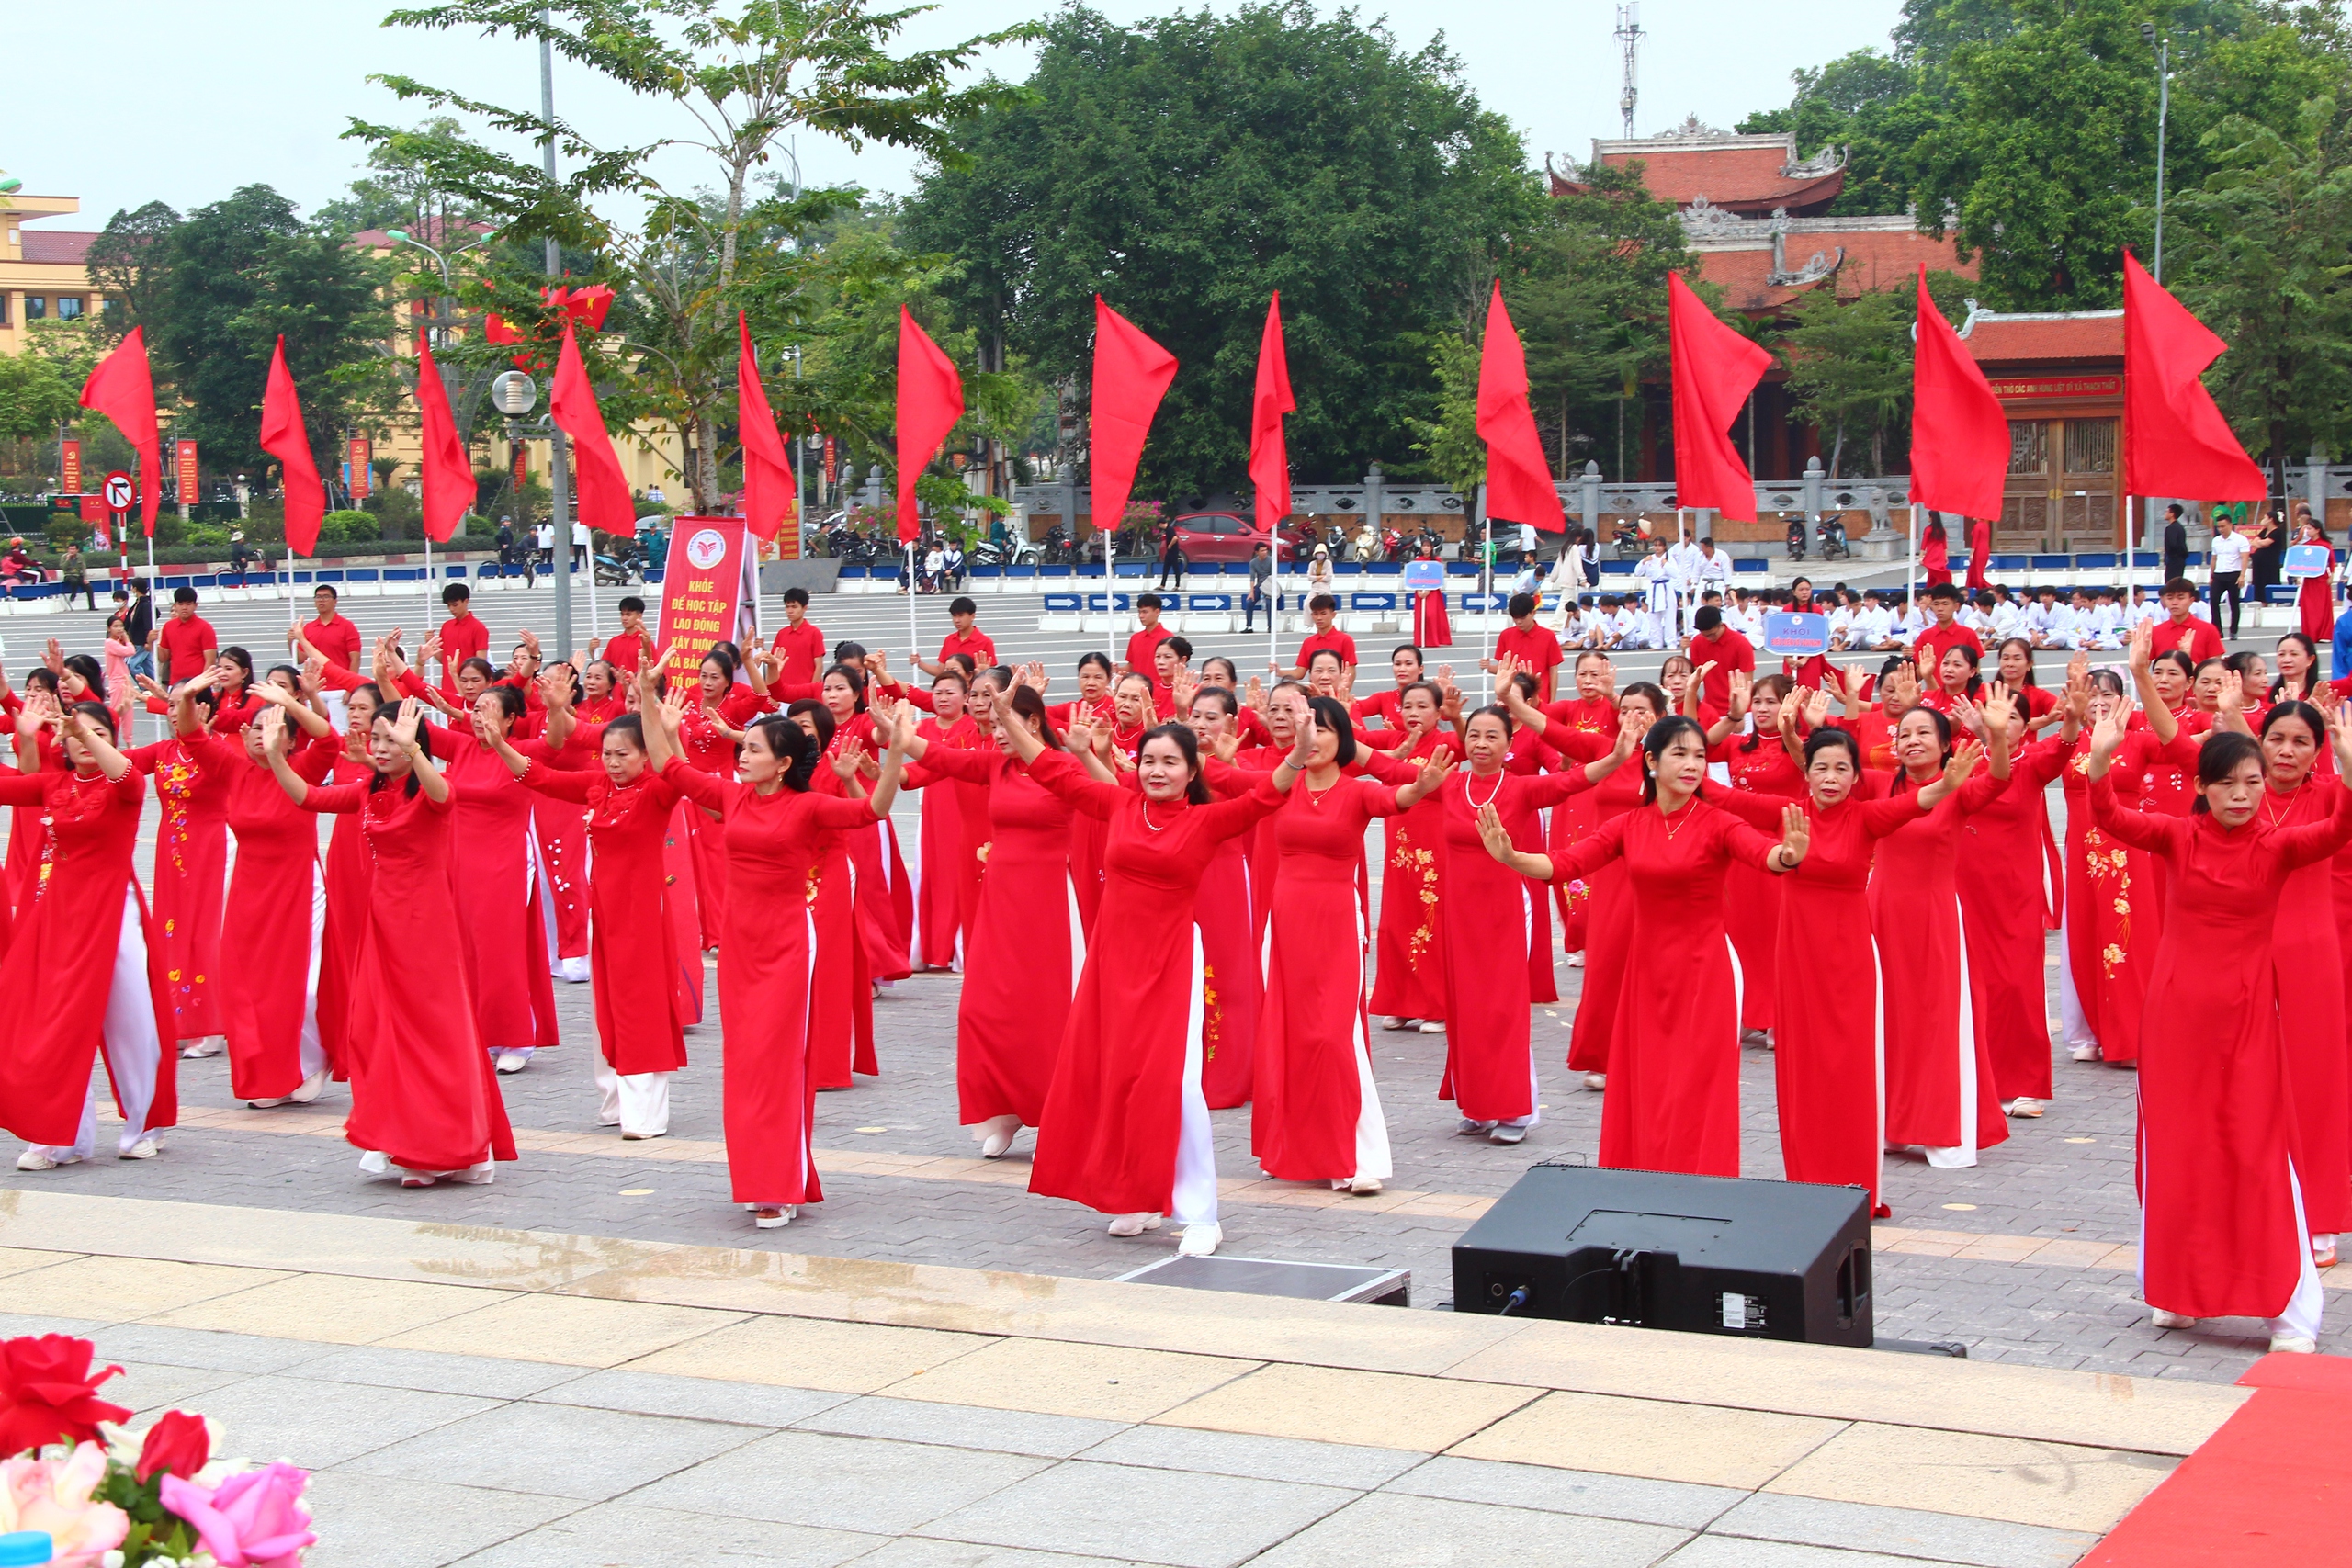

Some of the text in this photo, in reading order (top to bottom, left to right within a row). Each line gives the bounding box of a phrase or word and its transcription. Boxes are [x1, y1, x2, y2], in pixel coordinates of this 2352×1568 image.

[2015, 382, 2026, 393] CÁC
[2026, 383, 2038, 393] ANH
[689, 578, 714, 593] KHỎE
[672, 595, 727, 615] ĐỂ HỌC TẬP
[673, 617, 720, 634] LAO ĐỘNG
[672, 635, 690, 649] XÂY
[669, 656, 682, 670] VÀ
[672, 671, 684, 687] TỔ
